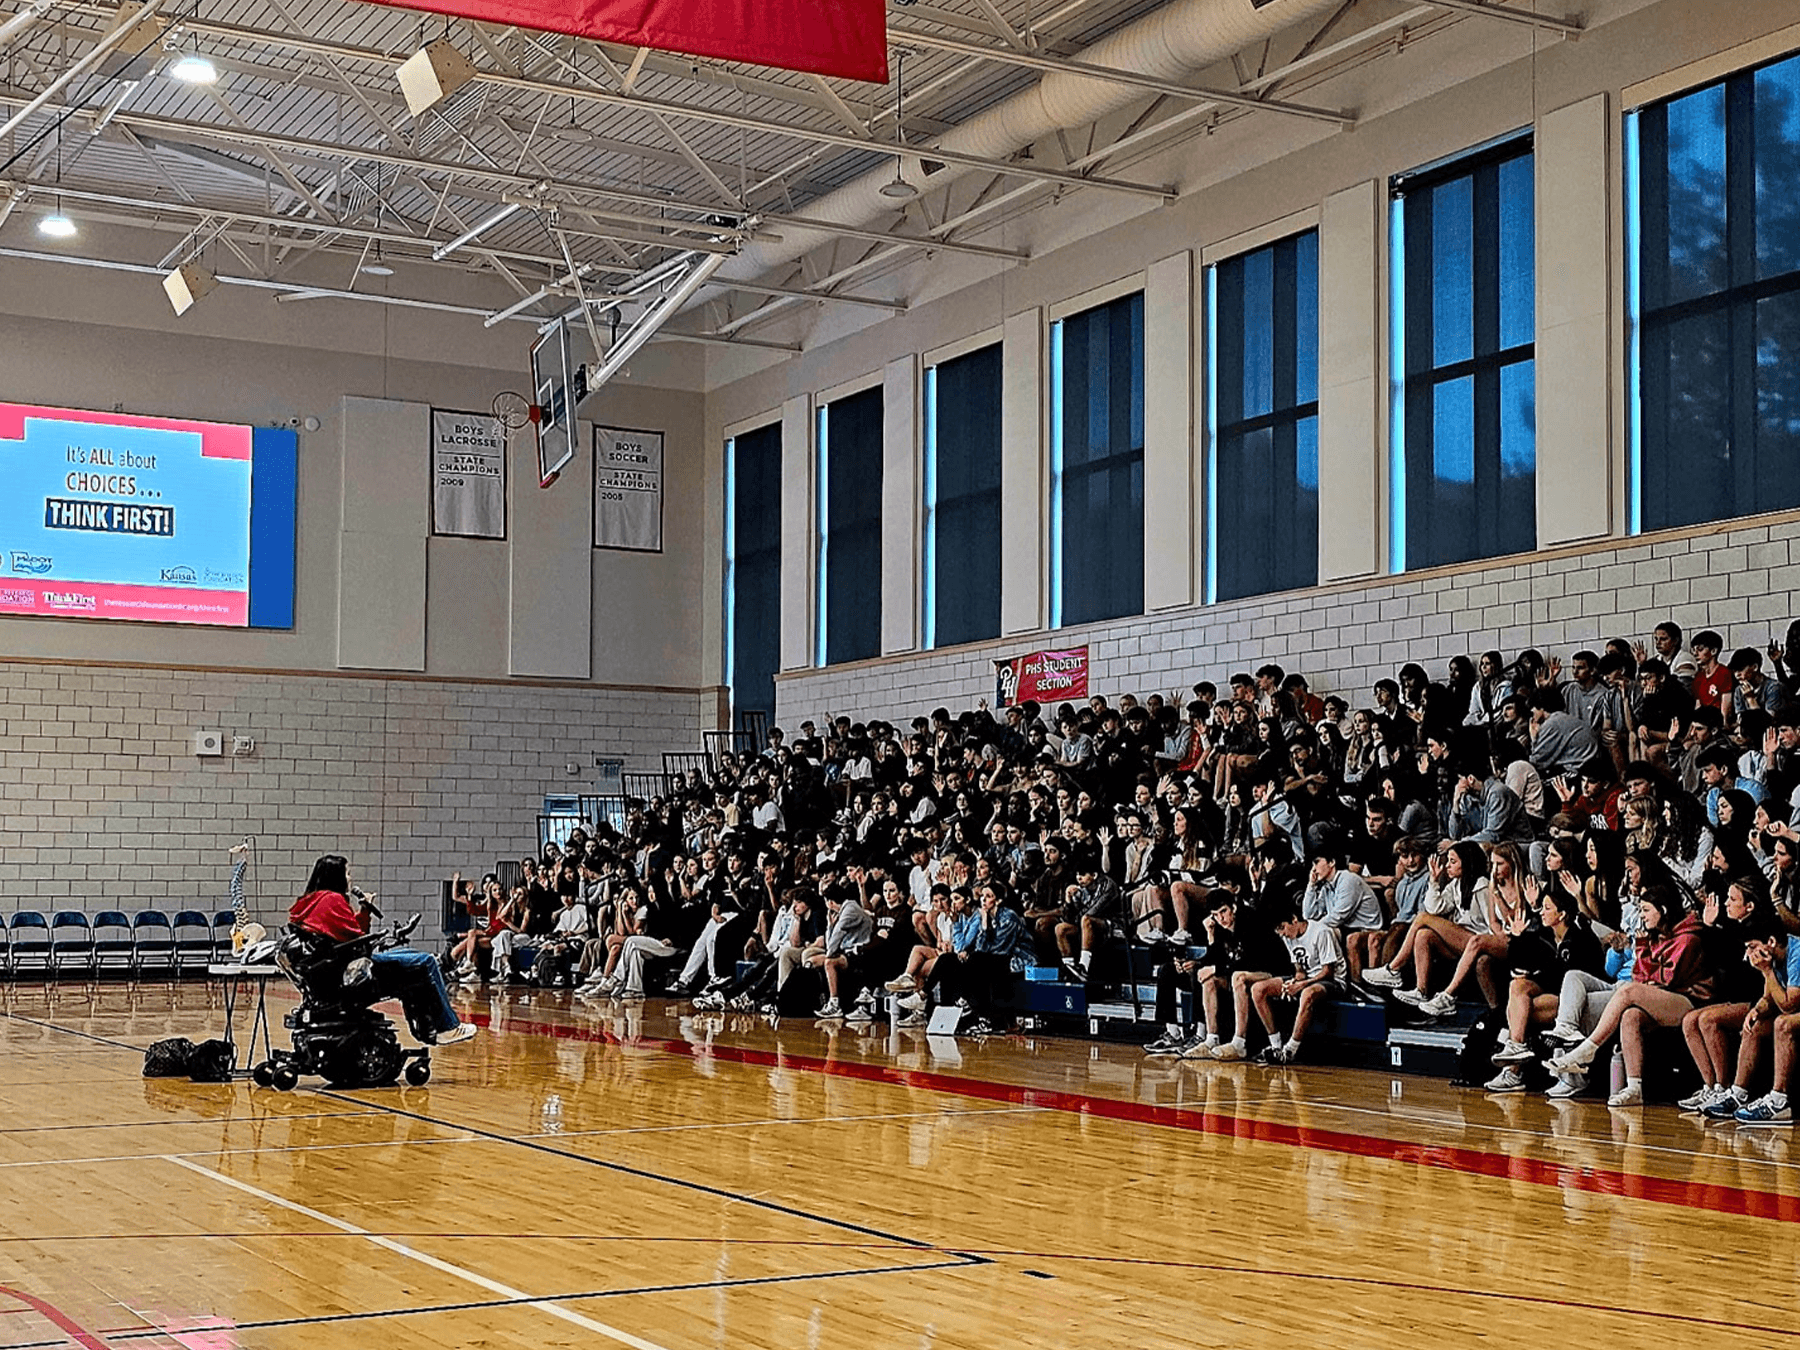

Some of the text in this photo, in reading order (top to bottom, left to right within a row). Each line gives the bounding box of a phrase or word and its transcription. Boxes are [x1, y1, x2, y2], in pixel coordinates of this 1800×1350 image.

[455, 424, 484, 436] BOYS
[441, 434, 497, 448] LACROSSE
[615, 442, 642, 453] BOYS
[67, 445, 156, 469] It's ALL about
[453, 456, 485, 465] STATE
[609, 452, 648, 464] SOCCER
[439, 463, 499, 474] CHAMPIONS
[614, 471, 643, 480] STATE
[600, 478, 657, 490] CHAMPIONS
[50, 501, 170, 534] THINK FIRST!
[1025, 657, 1086, 675] PHS STUDENT
[1036, 675, 1073, 691] SECTION
